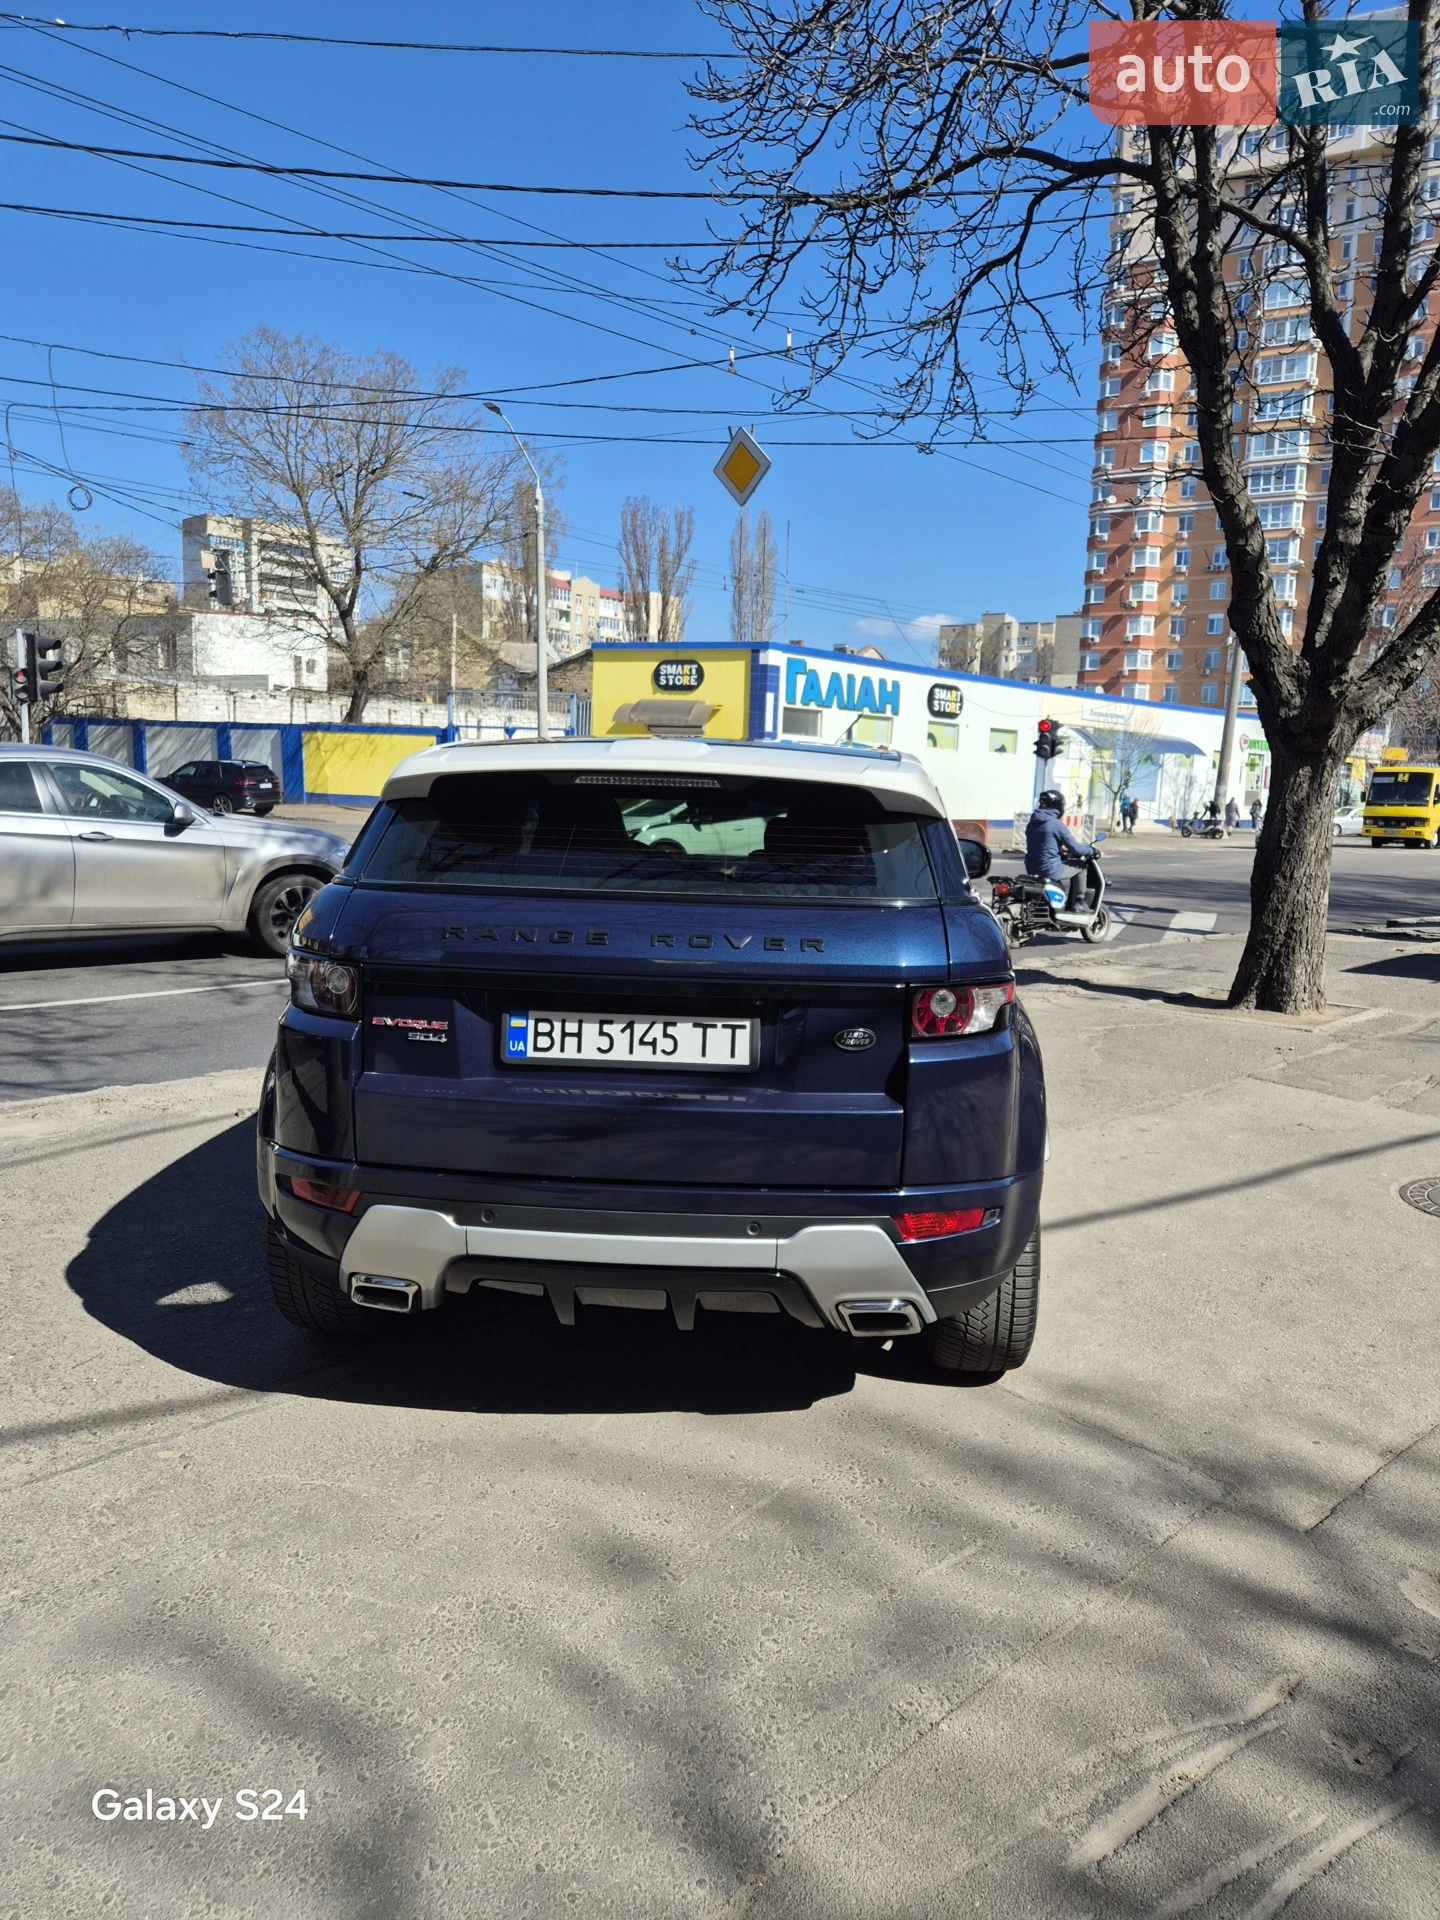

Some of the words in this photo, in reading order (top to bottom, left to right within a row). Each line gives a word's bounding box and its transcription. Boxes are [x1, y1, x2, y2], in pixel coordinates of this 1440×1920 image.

[659, 664, 698, 675] SMART
[659, 675, 698, 686] STORE
[785, 657, 900, 716] ГАЛІАН
[933, 688, 962, 702] SMART
[932, 700, 962, 713] STORE
[441, 926, 610, 946] RANGE
[650, 932, 826, 953] ROVER
[372, 1016, 448, 1030] EVOQUE
[408, 1031, 448, 1043] SD4
[532, 1018, 584, 1053] BH
[596, 1019, 679, 1056] 5145
[692, 1022, 748, 1059] TT
[843, 1031, 864, 1039] LAND
[509, 1040, 526, 1052] UA
